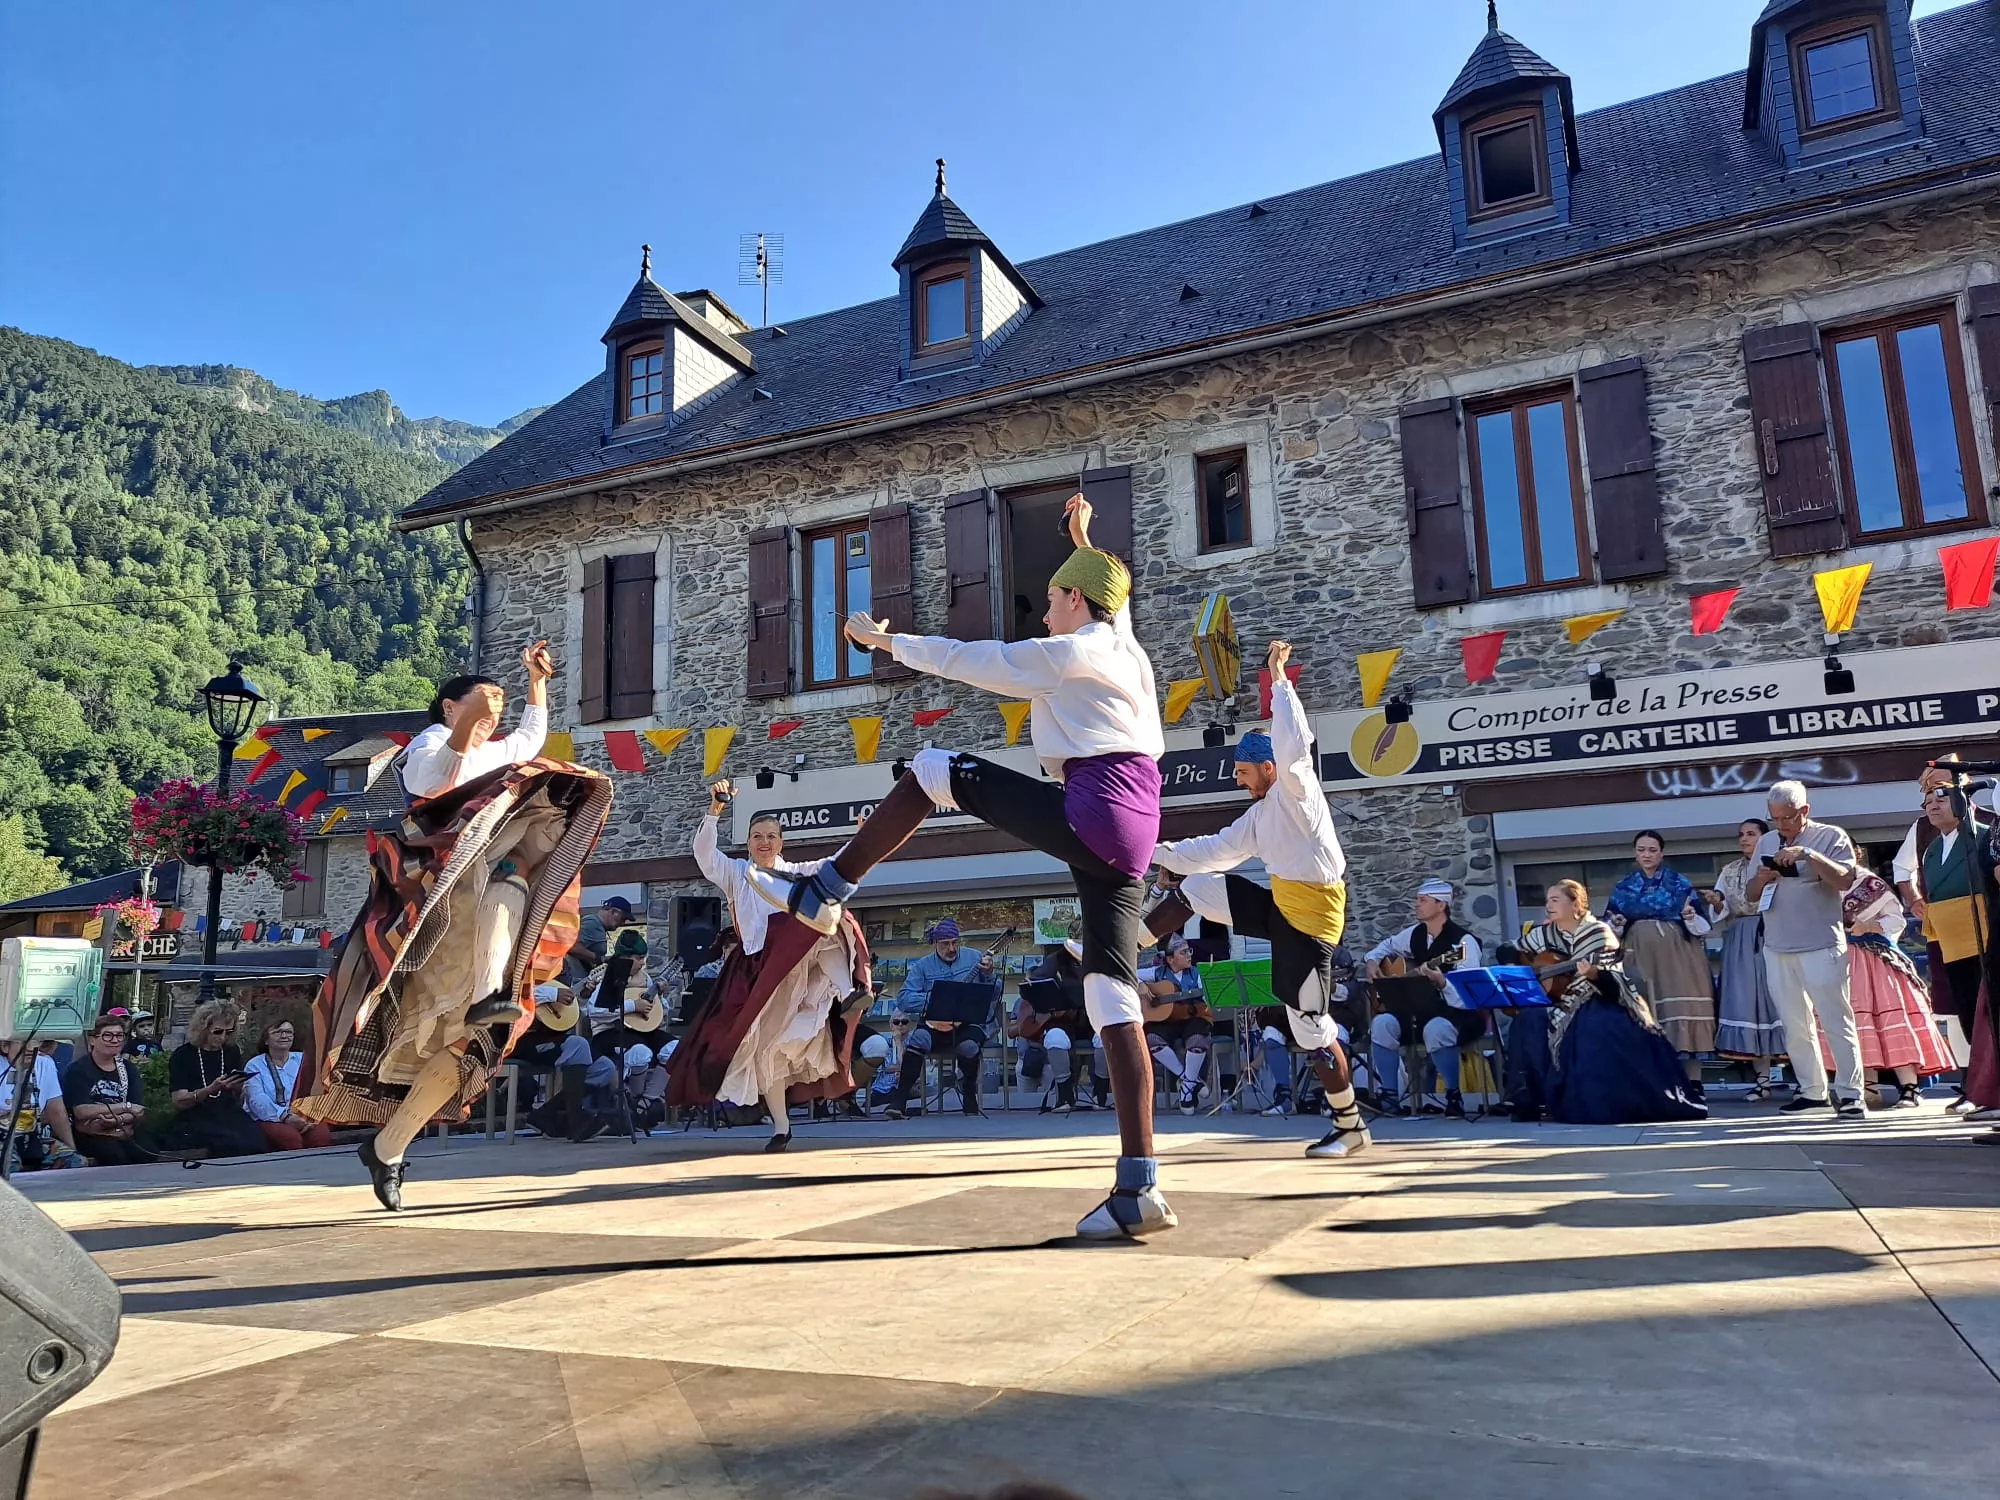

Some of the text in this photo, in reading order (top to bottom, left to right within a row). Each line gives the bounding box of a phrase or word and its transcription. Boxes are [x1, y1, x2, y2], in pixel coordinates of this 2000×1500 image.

[1447, 681, 1780, 732] Comptoir de la Presse
[1439, 737, 1553, 766] PRESSE
[1578, 719, 1739, 753] CARTERIE
[1768, 699, 1945, 736] LIBRAIRIE
[1174, 763, 1207, 785] Pic
[849, 803, 880, 822] LO
